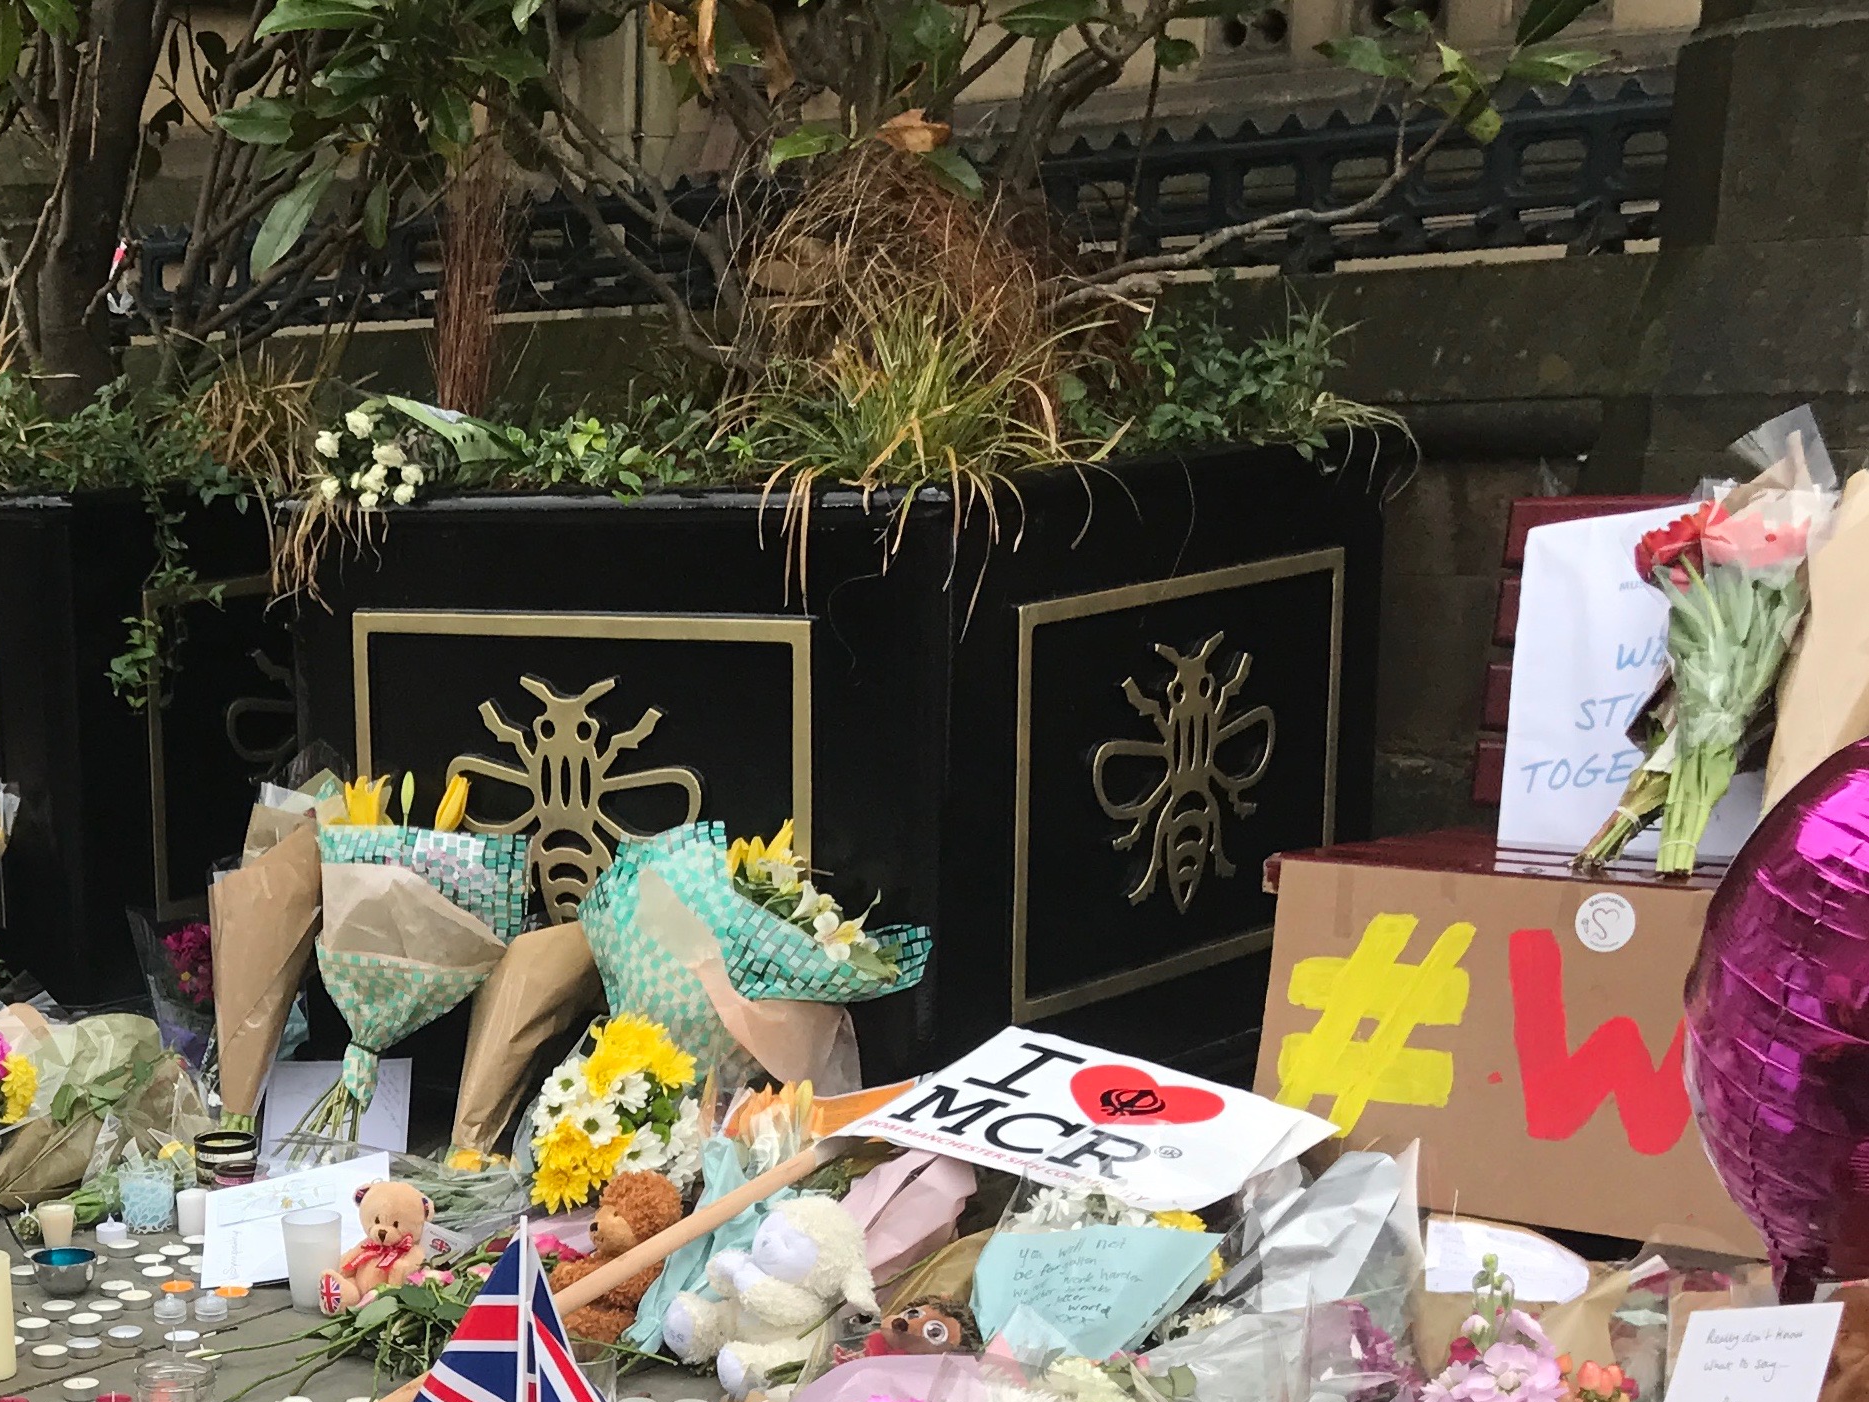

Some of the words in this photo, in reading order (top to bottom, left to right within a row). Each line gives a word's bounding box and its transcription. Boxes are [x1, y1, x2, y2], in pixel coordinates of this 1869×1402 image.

[1519, 750, 1645, 794] TOGE
[963, 1042, 1087, 1099] I
[888, 1085, 1152, 1181] MCR
[901, 1128, 1004, 1160] MANCHESTER
[1006, 1154, 1042, 1170] SIKH
